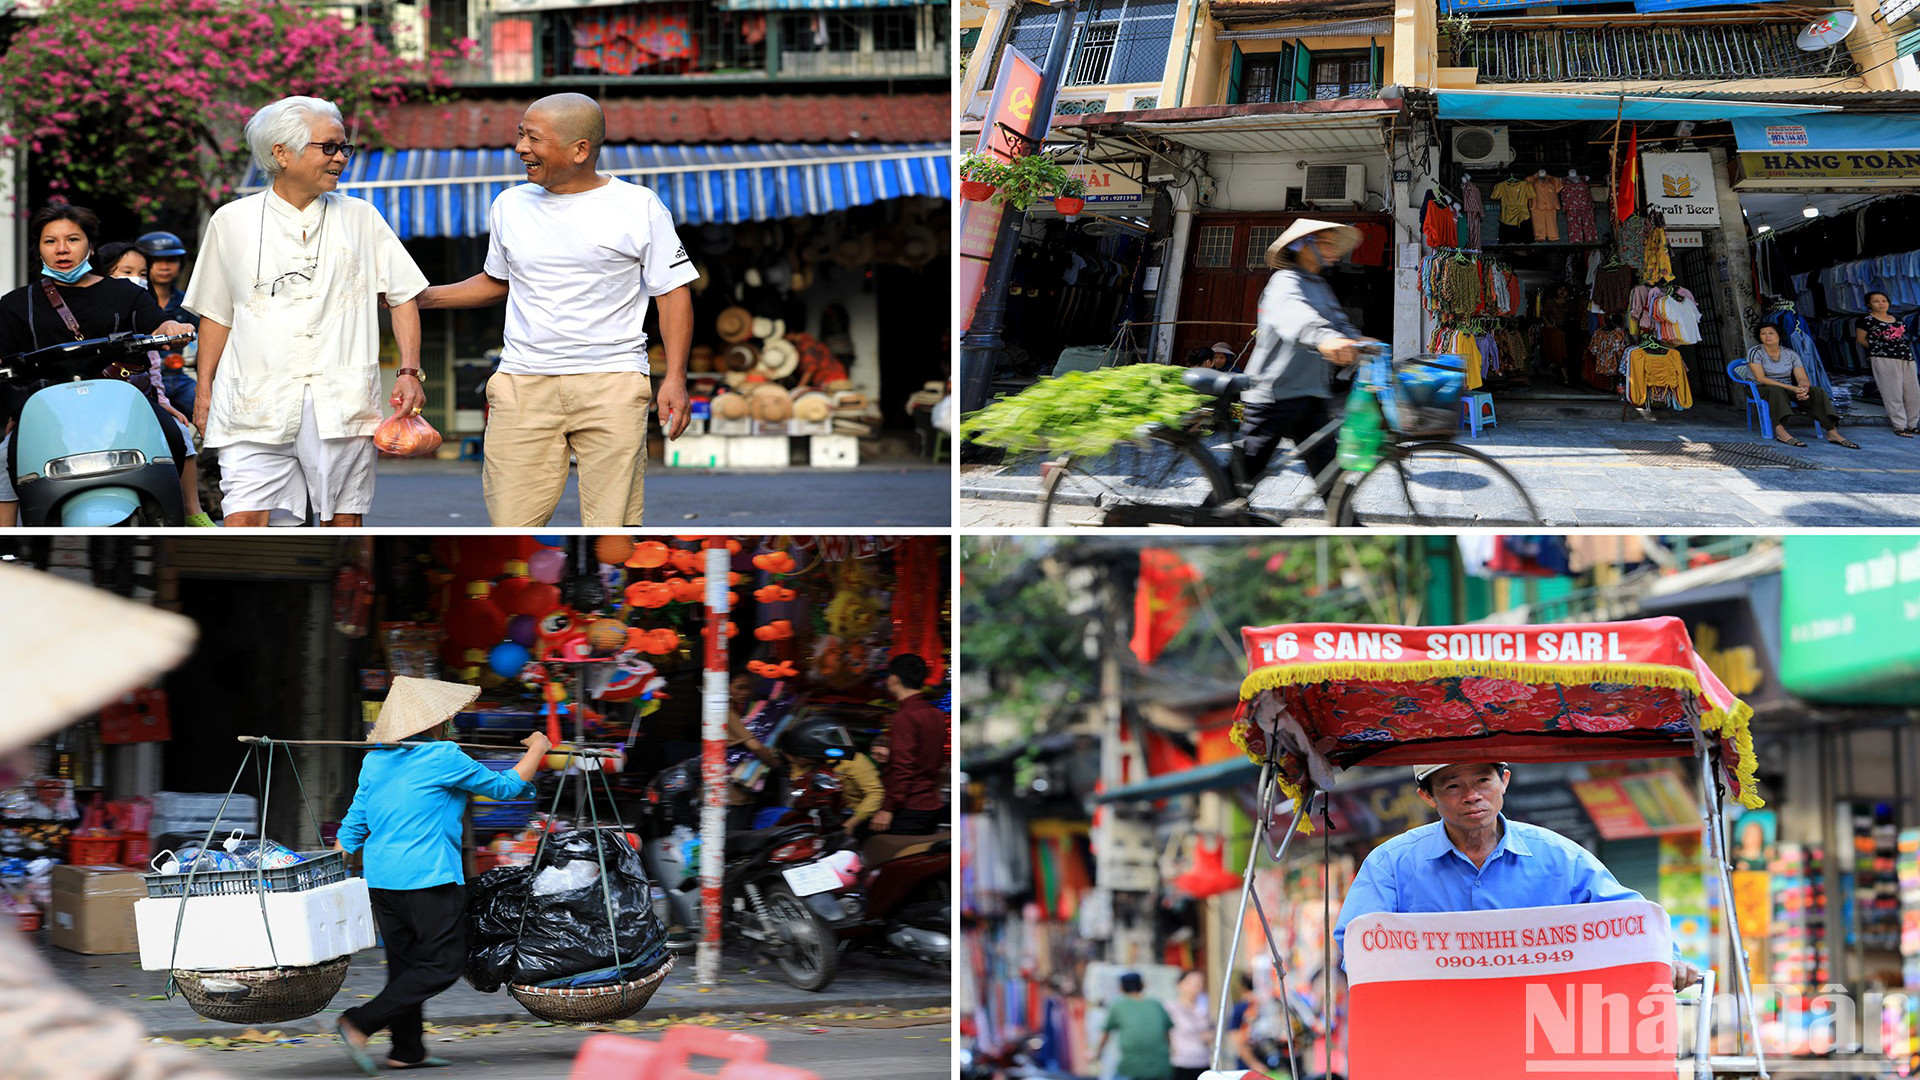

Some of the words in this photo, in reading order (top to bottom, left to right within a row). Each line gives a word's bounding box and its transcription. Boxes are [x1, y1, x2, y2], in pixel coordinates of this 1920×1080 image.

[1396, 172, 1408, 180] 22
[1686, 204, 1715, 214] Beer
[1260, 632, 1299, 662] 16
[1313, 632, 1403, 661] SANS
[1427, 632, 1526, 662] SOUCI
[1537, 632, 1627, 662] SARL
[1361, 922, 1419, 951] CÔNG
[1422, 930, 1451, 951] TY
[1456, 930, 1517, 950] TNHH
[1522, 924, 1578, 948] SANS
[1582, 915, 1646, 942] SOUCI
[1435, 949, 1575, 969] 0904.014.949
